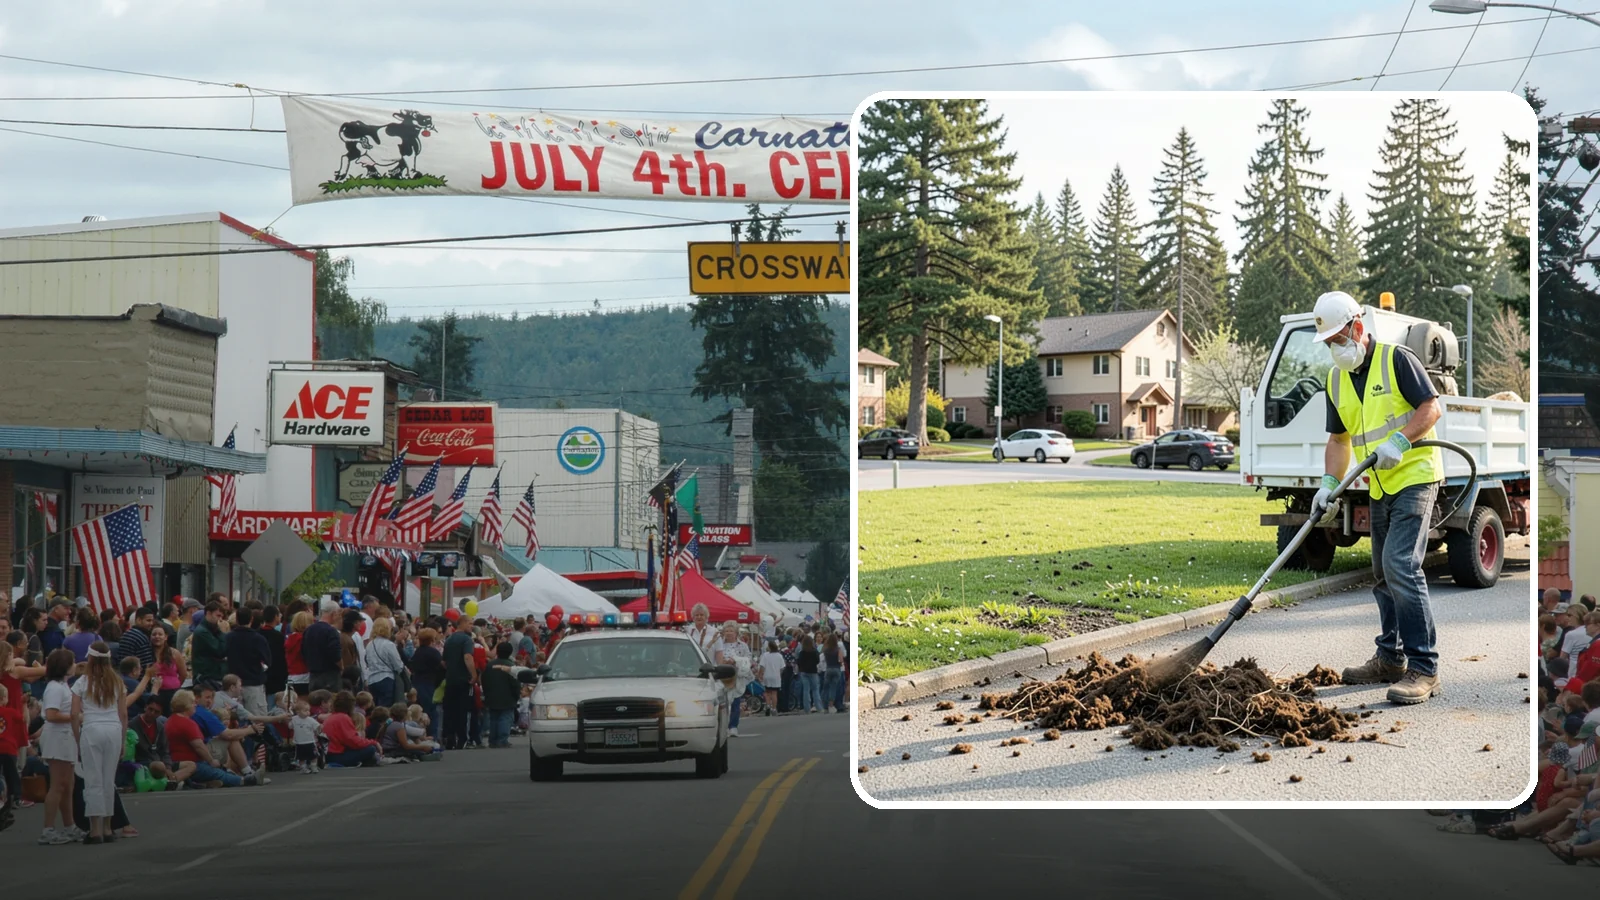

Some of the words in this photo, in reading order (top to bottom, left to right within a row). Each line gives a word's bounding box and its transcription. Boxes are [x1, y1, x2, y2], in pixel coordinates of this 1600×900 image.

[695, 121, 850, 150] Carnat
[481, 141, 605, 193] JULY
[632, 150, 746, 197] 4th.
[697, 254, 850, 280] CROSSWA
[283, 380, 373, 420] ACE
[406, 409, 453, 421] CEDAR
[461, 409, 485, 421] LOG
[283, 421, 371, 436] Hardware
[417, 428, 477, 447] Coca-Cola
[83, 484, 94, 494] St.
[95, 485, 124, 495] Vincent
[126, 486, 135, 495] de
[137, 486, 155, 495] Paul
[688, 526, 742, 535] CRNATION
[699, 535, 730, 543] GLASS
